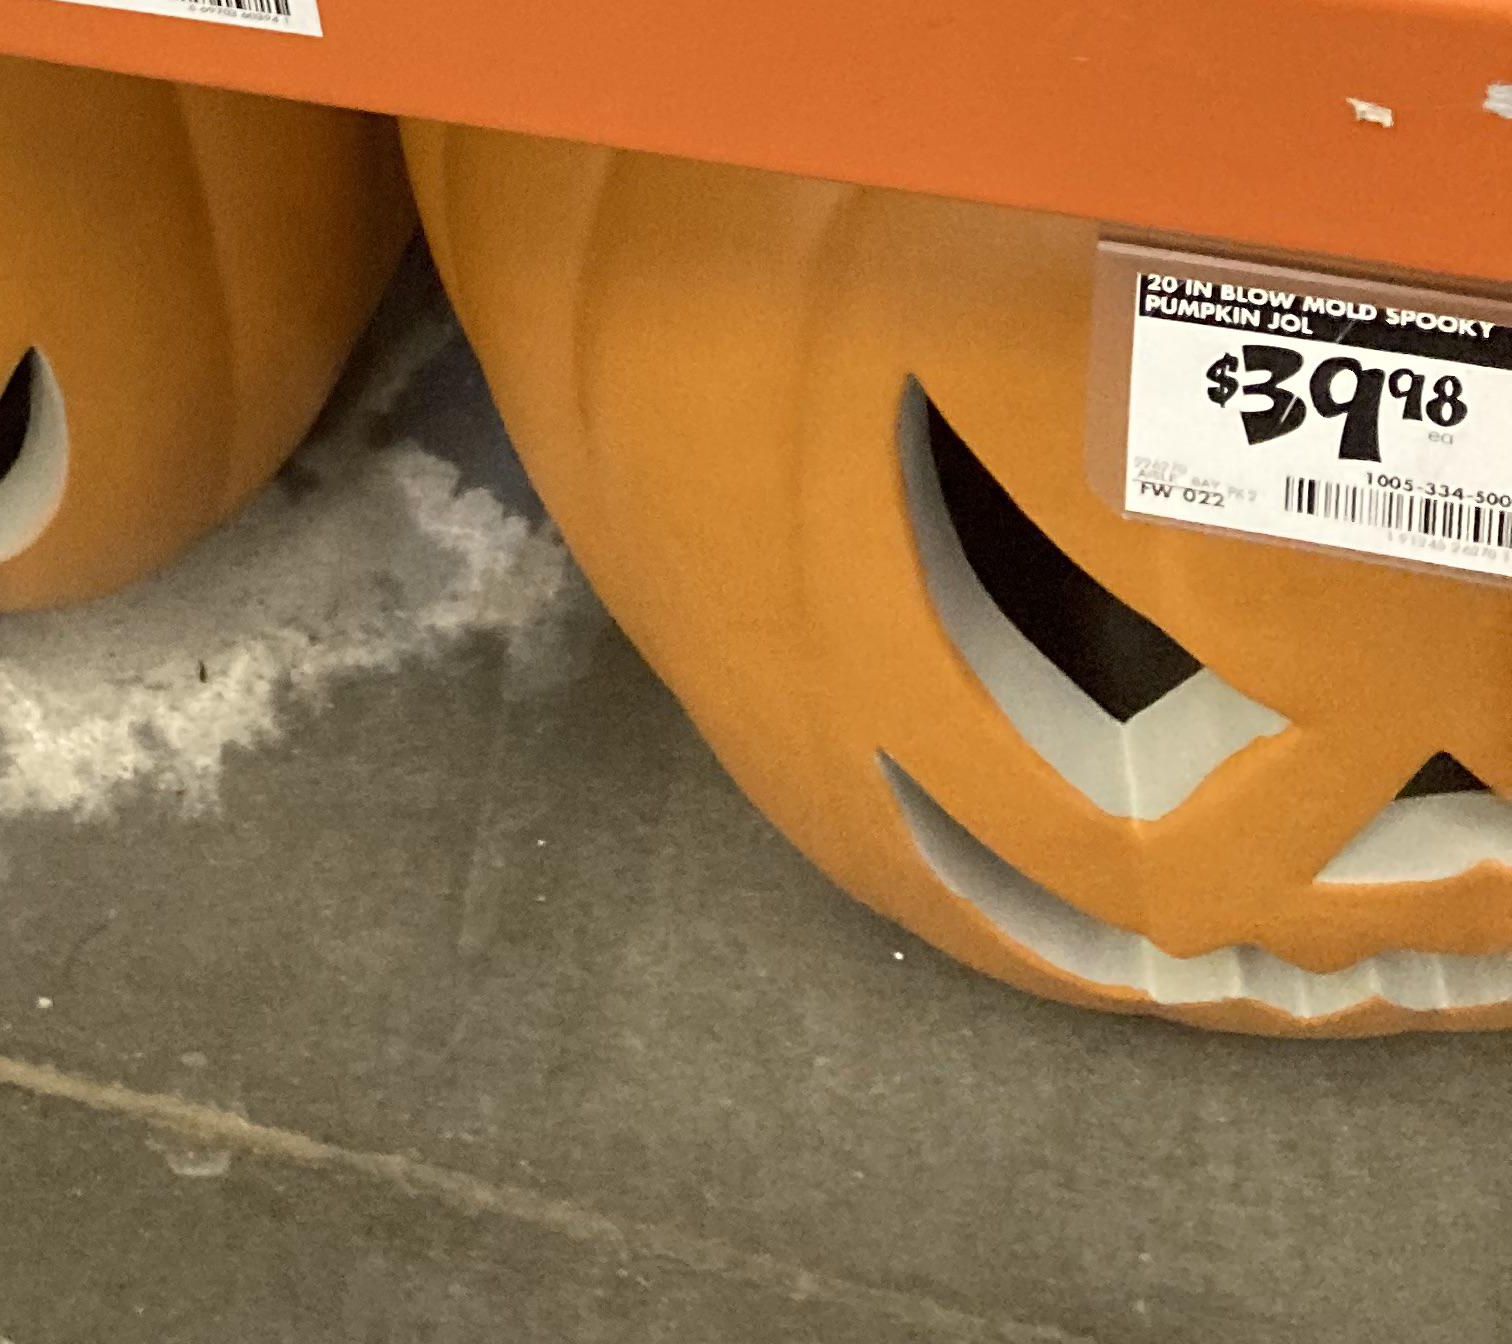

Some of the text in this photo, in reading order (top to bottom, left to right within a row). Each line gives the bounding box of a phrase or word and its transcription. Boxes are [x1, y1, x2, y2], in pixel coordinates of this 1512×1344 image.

[1145, 294, 1314, 336] PUMPKIN JOL
[1147, 273, 1497, 340] 20 IN BLOW MOLD SPOOKY
[1141, 481, 1225, 507] FW 022
[1366, 472, 1512, 508] 1005-334-500
